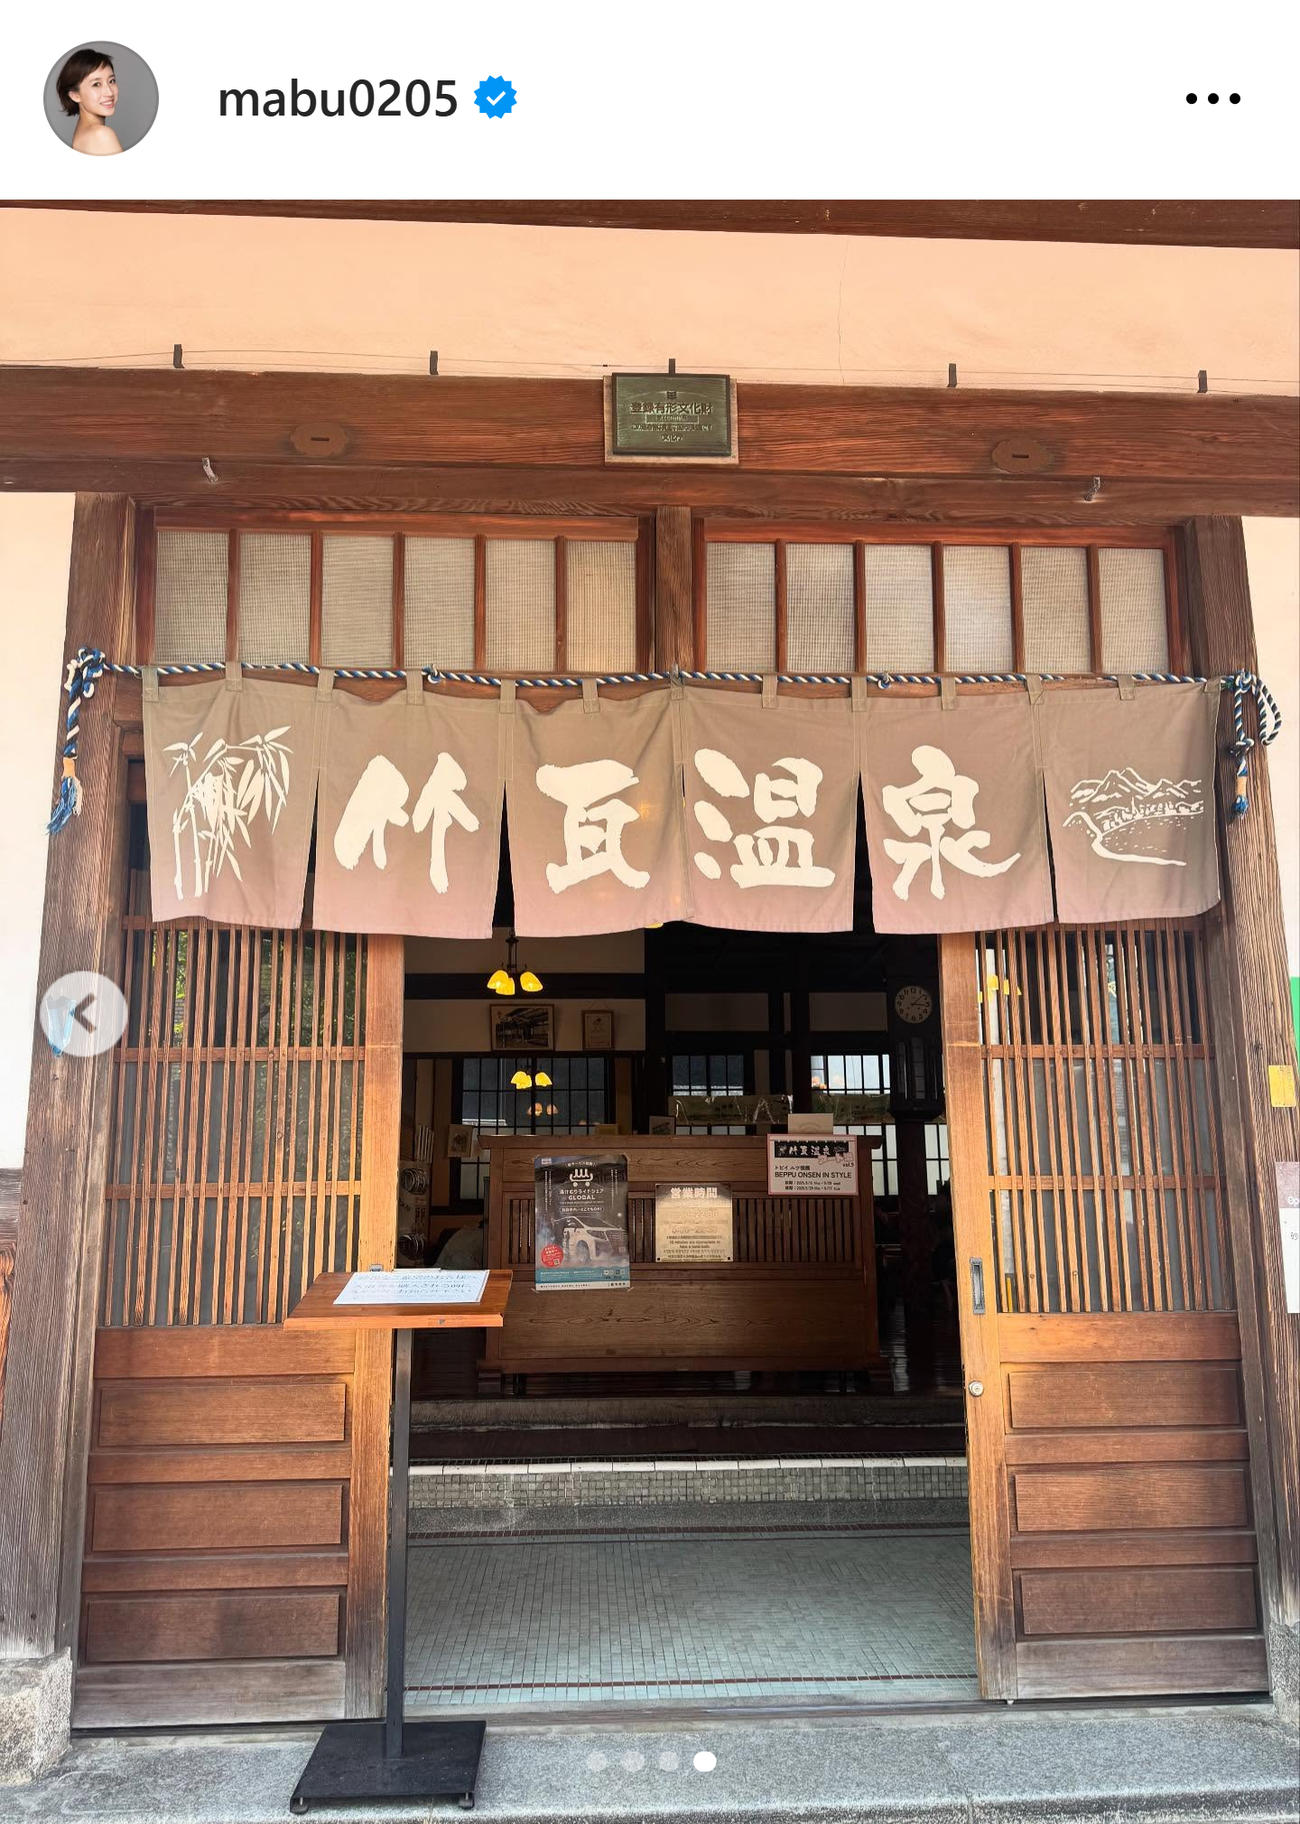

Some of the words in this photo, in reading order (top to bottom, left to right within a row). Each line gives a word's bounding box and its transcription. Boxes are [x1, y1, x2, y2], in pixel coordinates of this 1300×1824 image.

[333, 744, 1022, 901] 竹瓦温泉
[670, 1187, 718, 1199] 営業時間
